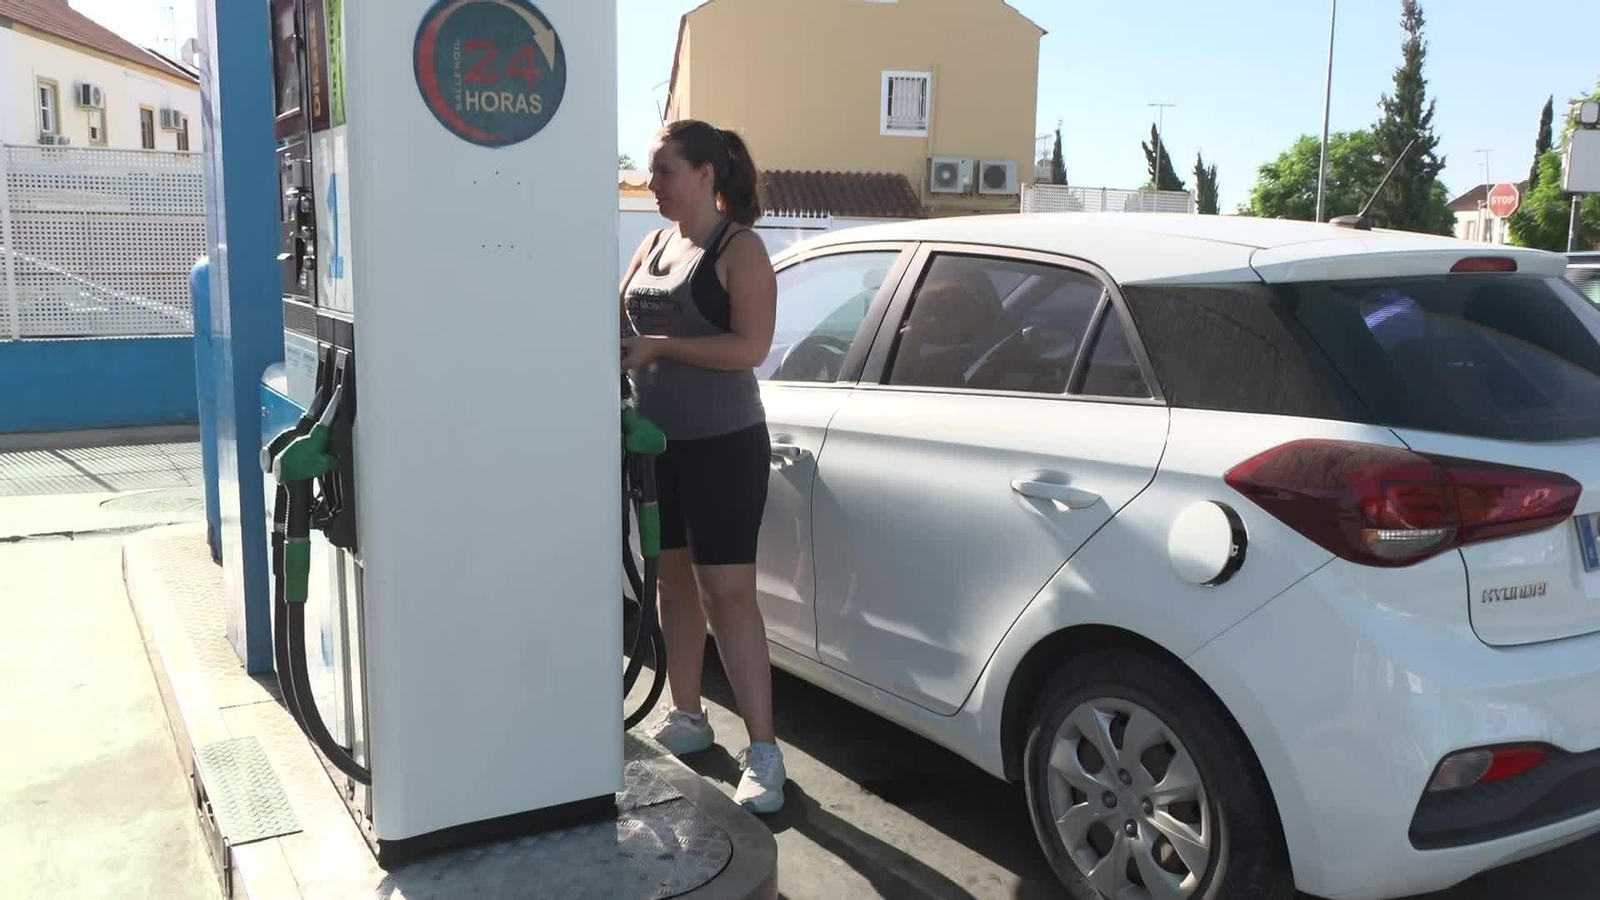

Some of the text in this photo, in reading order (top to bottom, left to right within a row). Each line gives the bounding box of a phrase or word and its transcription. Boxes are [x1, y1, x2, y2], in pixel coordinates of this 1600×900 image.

[465, 39, 541, 87] 24
[465, 90, 543, 114] HORAS
[1490, 195, 1515, 205] STOP
[1481, 582, 1547, 604] HYUNDAI
